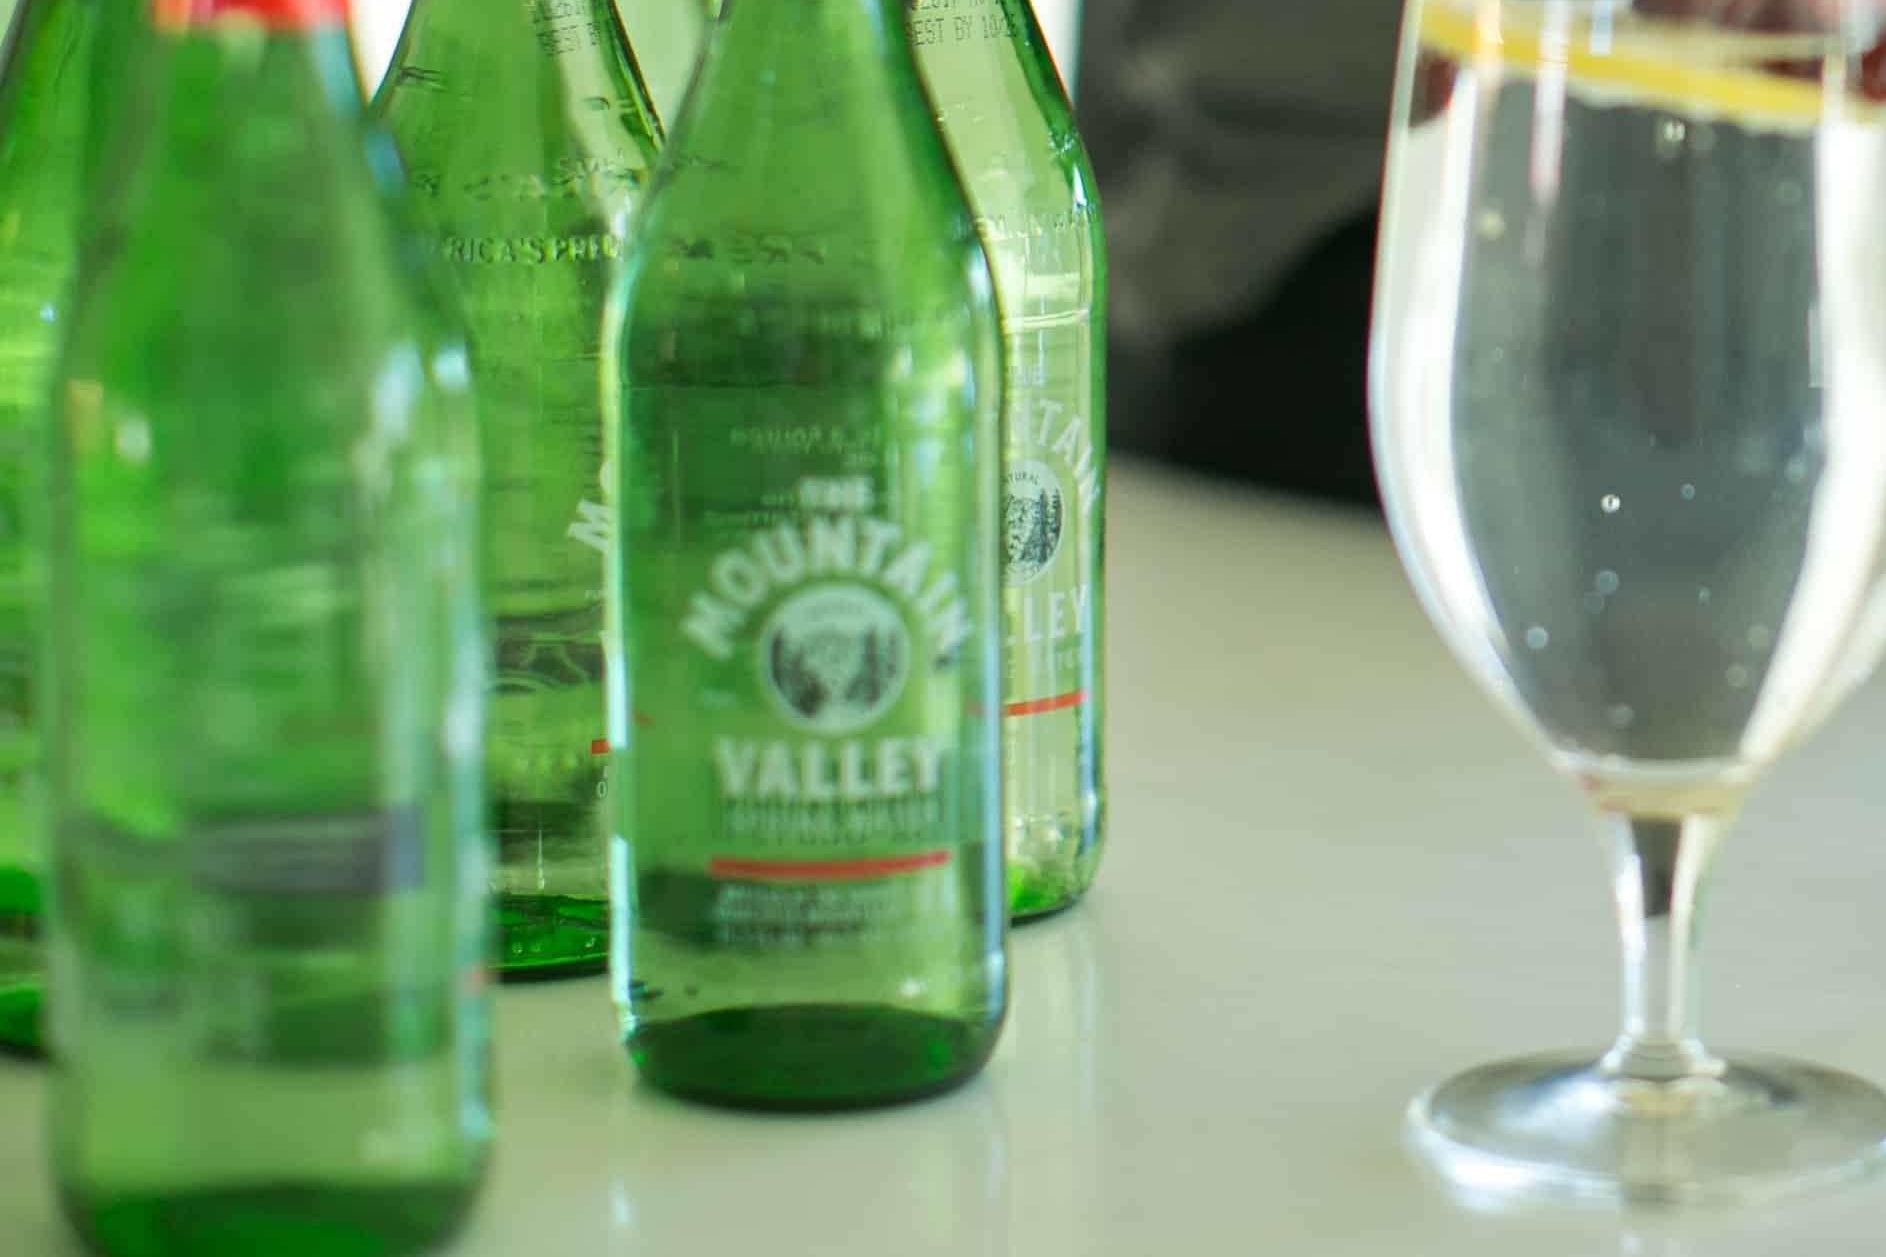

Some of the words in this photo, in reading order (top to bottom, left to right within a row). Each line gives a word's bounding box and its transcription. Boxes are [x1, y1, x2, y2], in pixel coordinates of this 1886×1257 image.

[683, 516, 973, 660] MOUNTAIN
[1023, 583, 1087, 640] LEY
[711, 733, 950, 799] VALLEY
